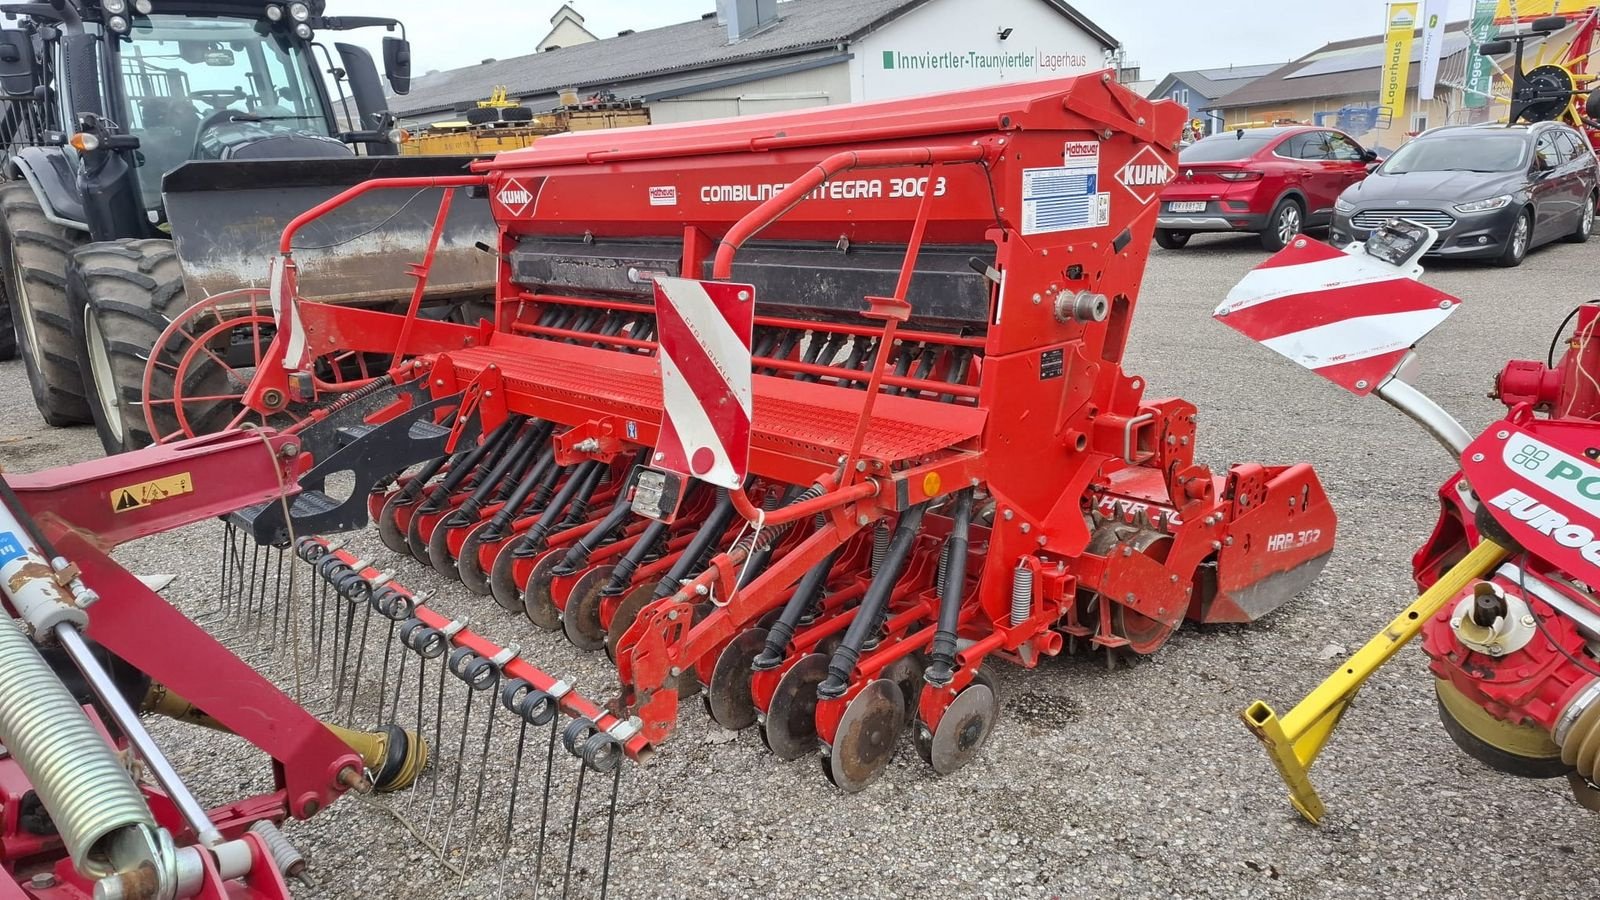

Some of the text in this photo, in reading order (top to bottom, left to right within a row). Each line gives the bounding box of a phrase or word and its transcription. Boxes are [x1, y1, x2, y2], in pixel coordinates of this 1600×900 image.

[898, 51, 1086, 71] Innviertler-Traunviertler Lagerhaus
[1386, 41, 1402, 104] Lagerhaus
[1124, 164, 1168, 185] KUHN
[501, 190, 528, 204] KUHN
[700, 183, 793, 202] COMBILINE
[1267, 529, 1321, 552] HRB 302
